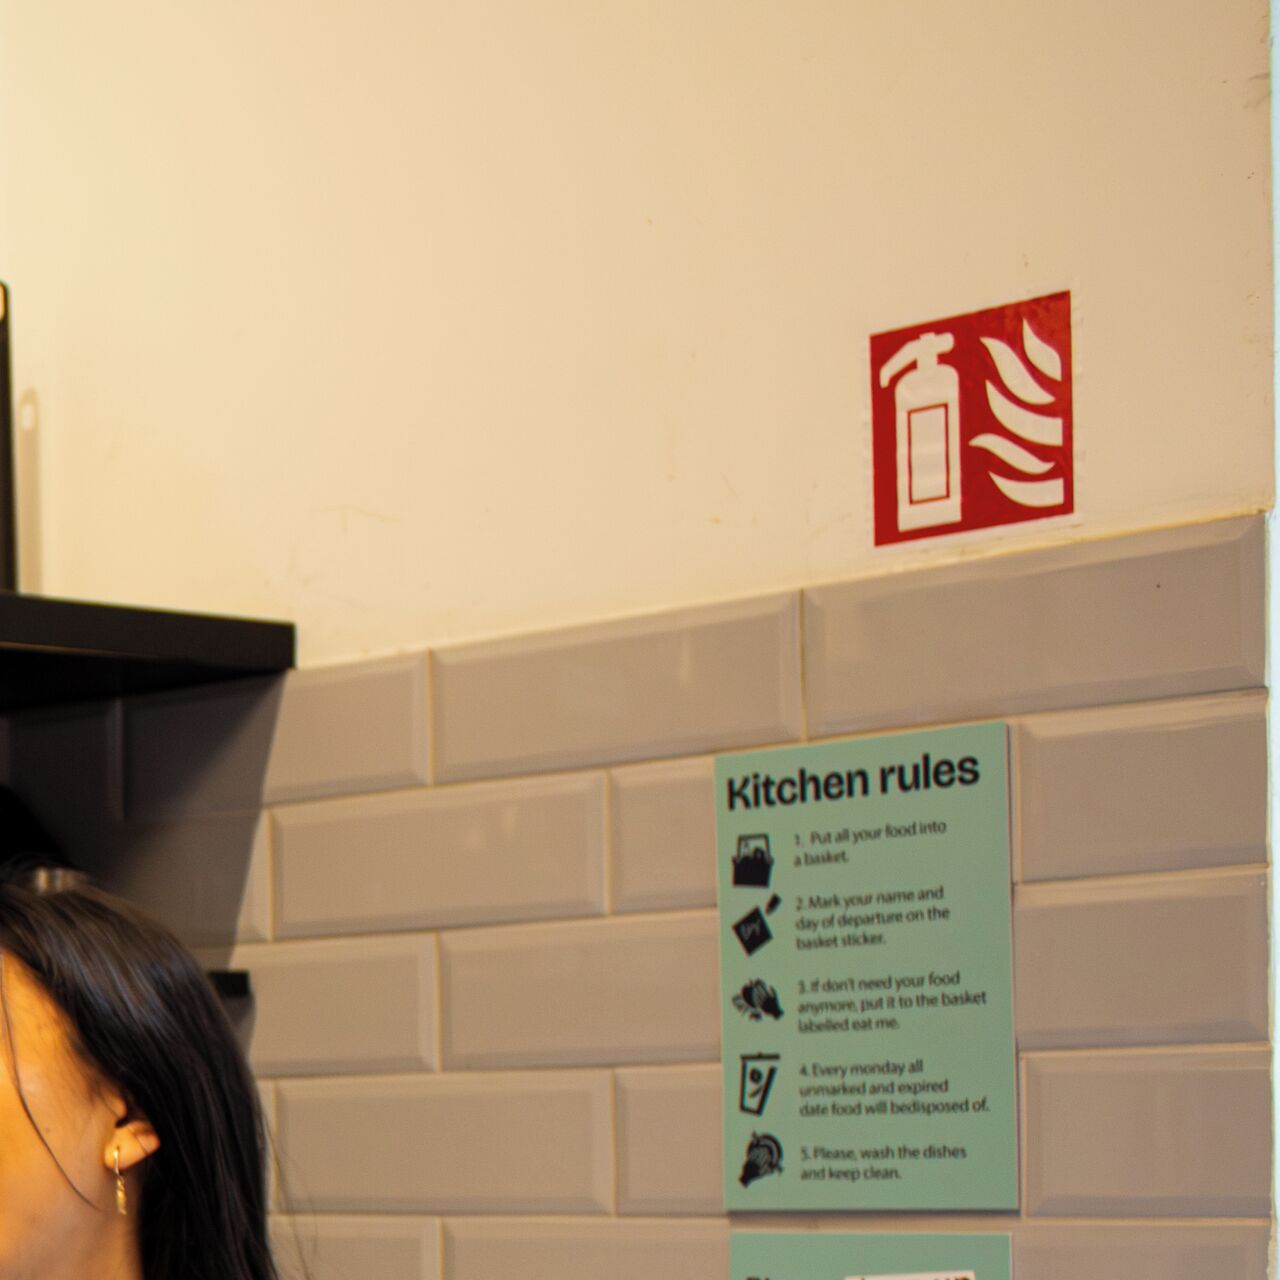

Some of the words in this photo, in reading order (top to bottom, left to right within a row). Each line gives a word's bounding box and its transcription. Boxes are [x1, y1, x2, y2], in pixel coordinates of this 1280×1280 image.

[727, 767, 870, 812] Kitchen
[879, 752, 981, 795] rules
[810, 830, 832, 846] Put
[835, 827, 849, 843] all
[851, 827, 883, 845] your
[885, 822, 917, 837] food
[919, 820, 947, 835] into
[793, 856, 802, 867] a
[804, 849, 850, 866] basket.
[808, 893, 841, 909] Mark
[842, 894, 873, 910] your
[876, 890, 915, 904] name
[917, 885, 944, 900] and
[795, 916, 818, 933] day
[821, 914, 836, 929] of
[837, 910, 903, 929] departure
[905, 910, 925, 922] on
[927, 906, 951, 921] the
[795, 934, 838, 951] basket
[858, 975, 892, 991] need
[894, 976, 925, 993] your
[928, 970, 961, 987] food
[860, 996, 884, 1013] put
[886, 995, 896, 1010] it
[898, 995, 914, 1009] to
[915, 993, 939, 1008] the
[940, 990, 987, 1007] basket
[797, 1018, 850, 1034] labelled
[851, 1018, 873, 1032] eat
[812, 1061, 848, 1079] Every
[850, 1059, 906, 1078] monday
[908, 1058, 924, 1074] all
[799, 1080, 866, 1098] unmarked
[868, 1080, 895, 1095] and
[897, 1079, 949, 1097] expired
[799, 1102, 829, 1118] date
[831, 1101, 862, 1116] food
[864, 1100, 888, 1116] will
[860, 1145, 895, 1160] wash
[897, 1144, 920, 1159] the
[922, 1144, 967, 1159] dishes
[800, 1166, 826, 1181] and
[828, 1166, 861, 1182] keep
